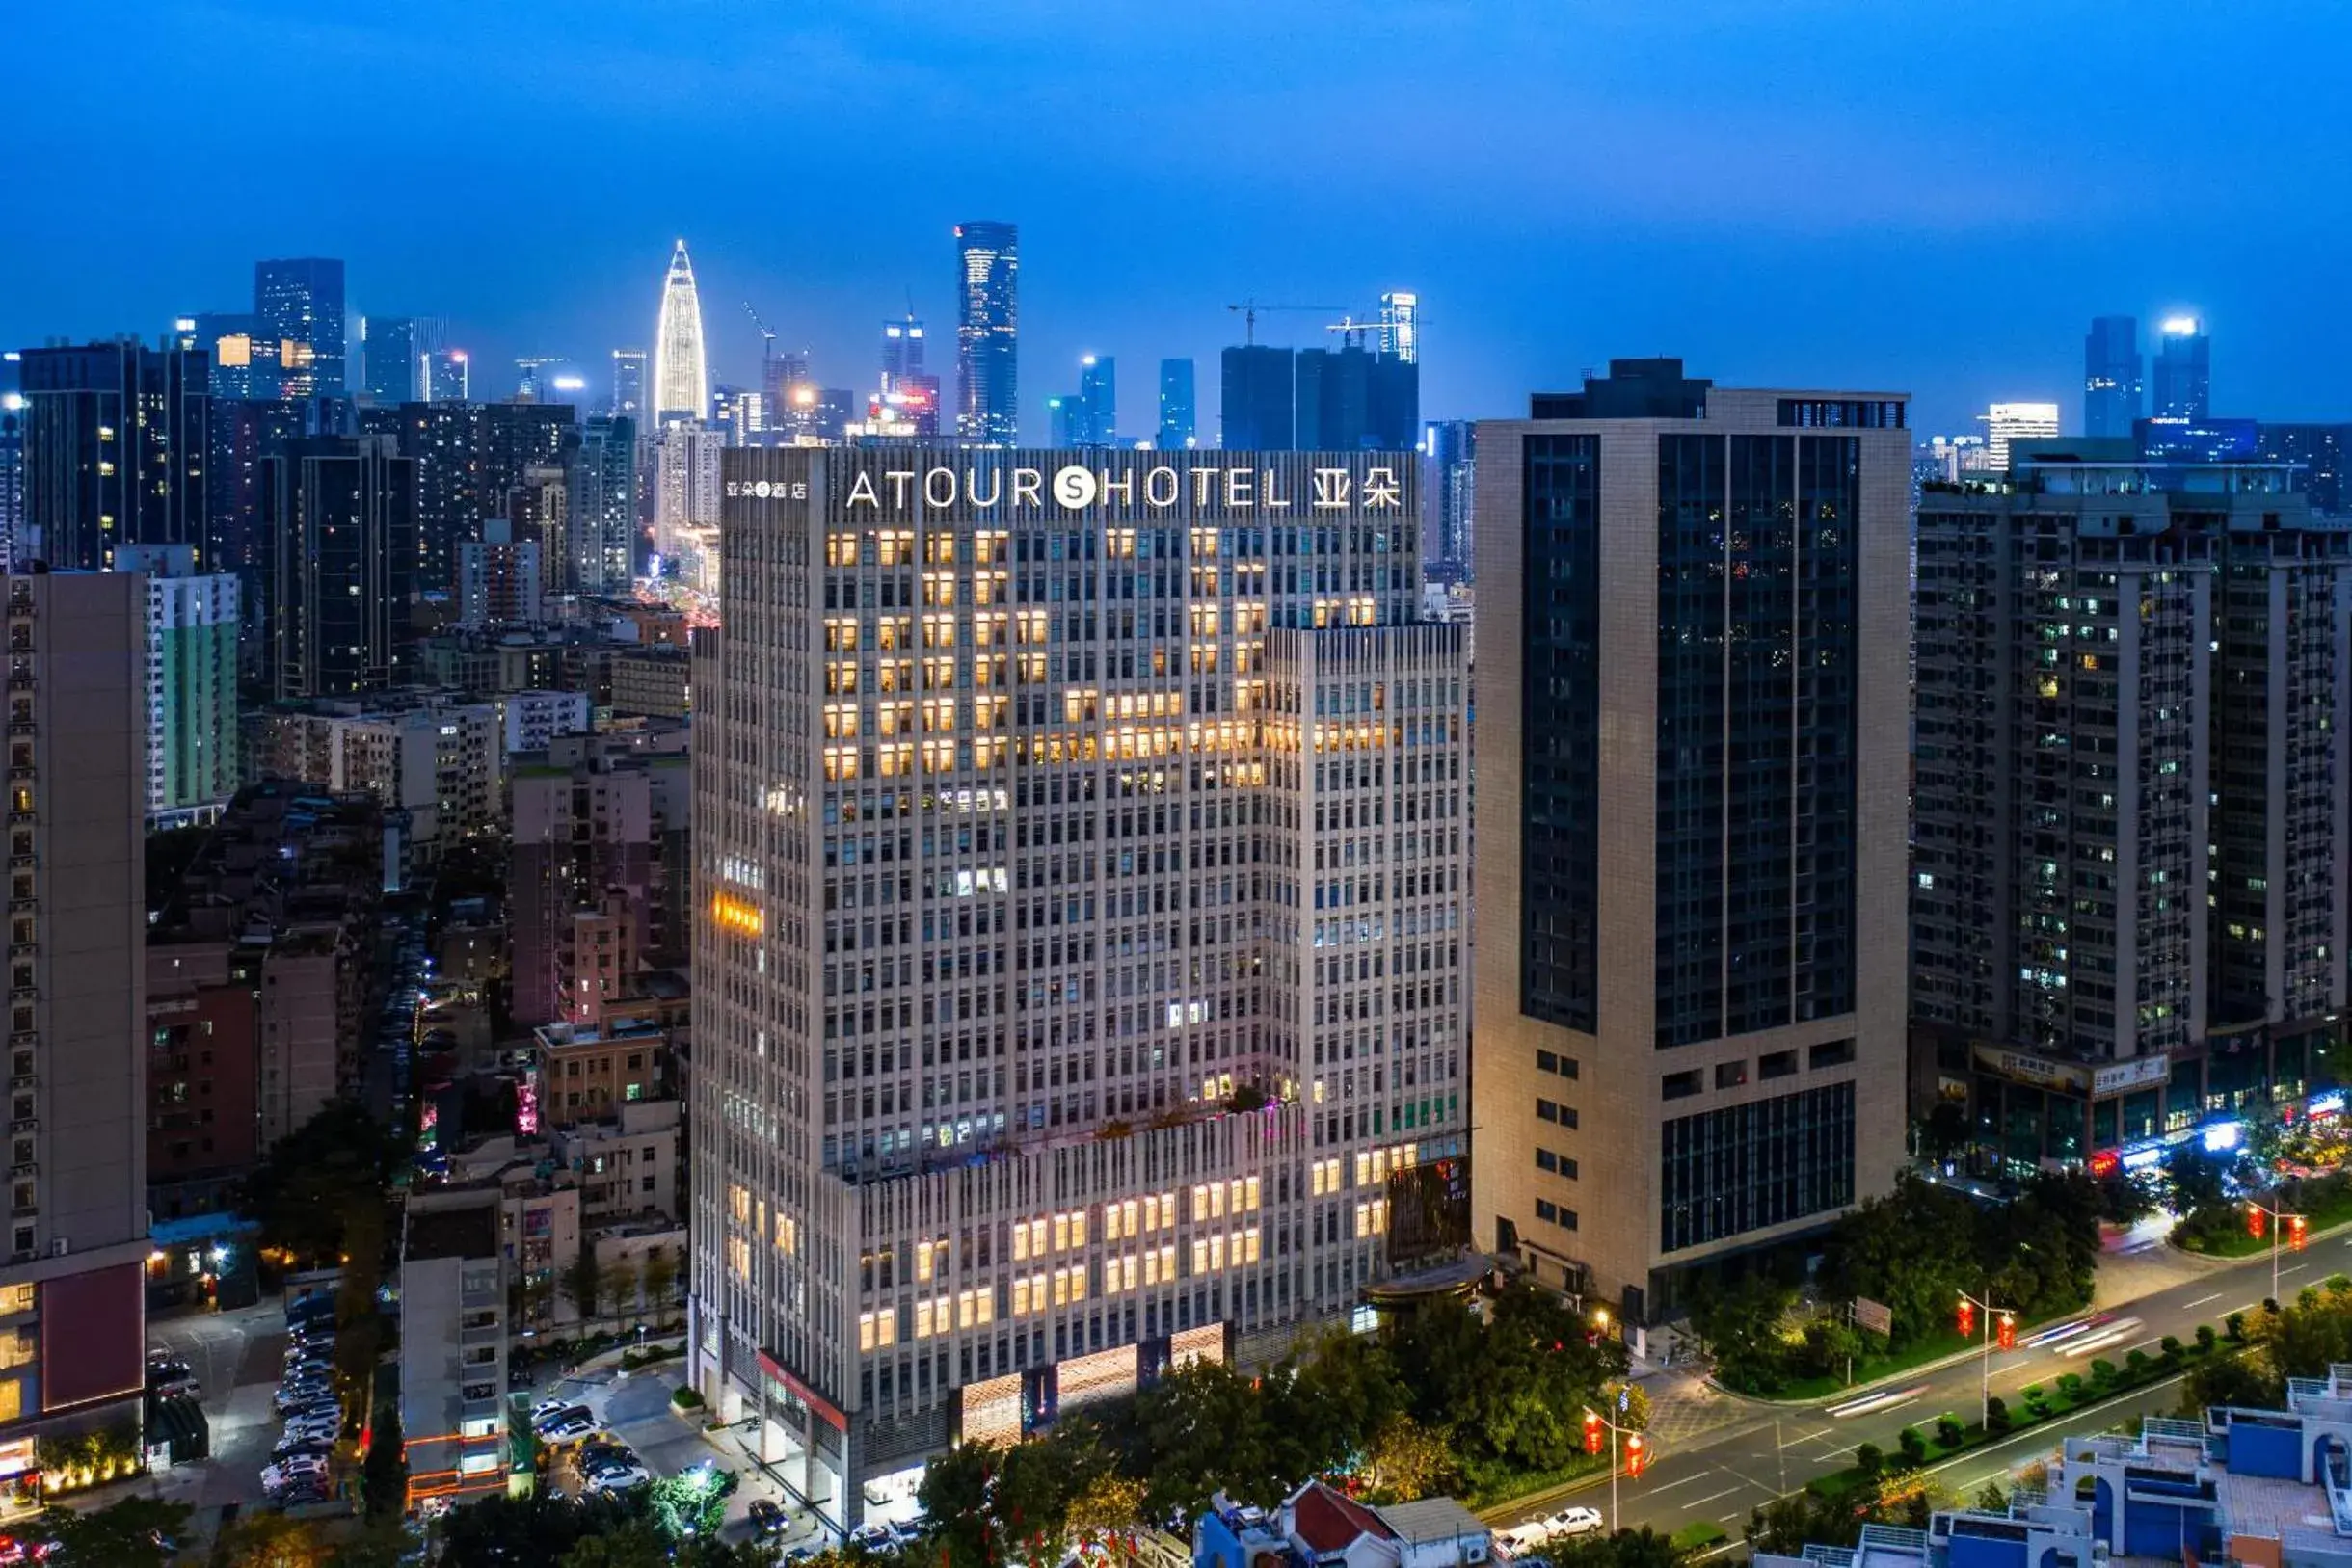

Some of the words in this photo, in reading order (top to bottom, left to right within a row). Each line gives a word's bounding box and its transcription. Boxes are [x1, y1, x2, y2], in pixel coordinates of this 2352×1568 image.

[846, 467, 1042, 508] ATOUR
[1102, 466, 1290, 508] HOTEL
[1313, 467, 1401, 508] 亚朵
